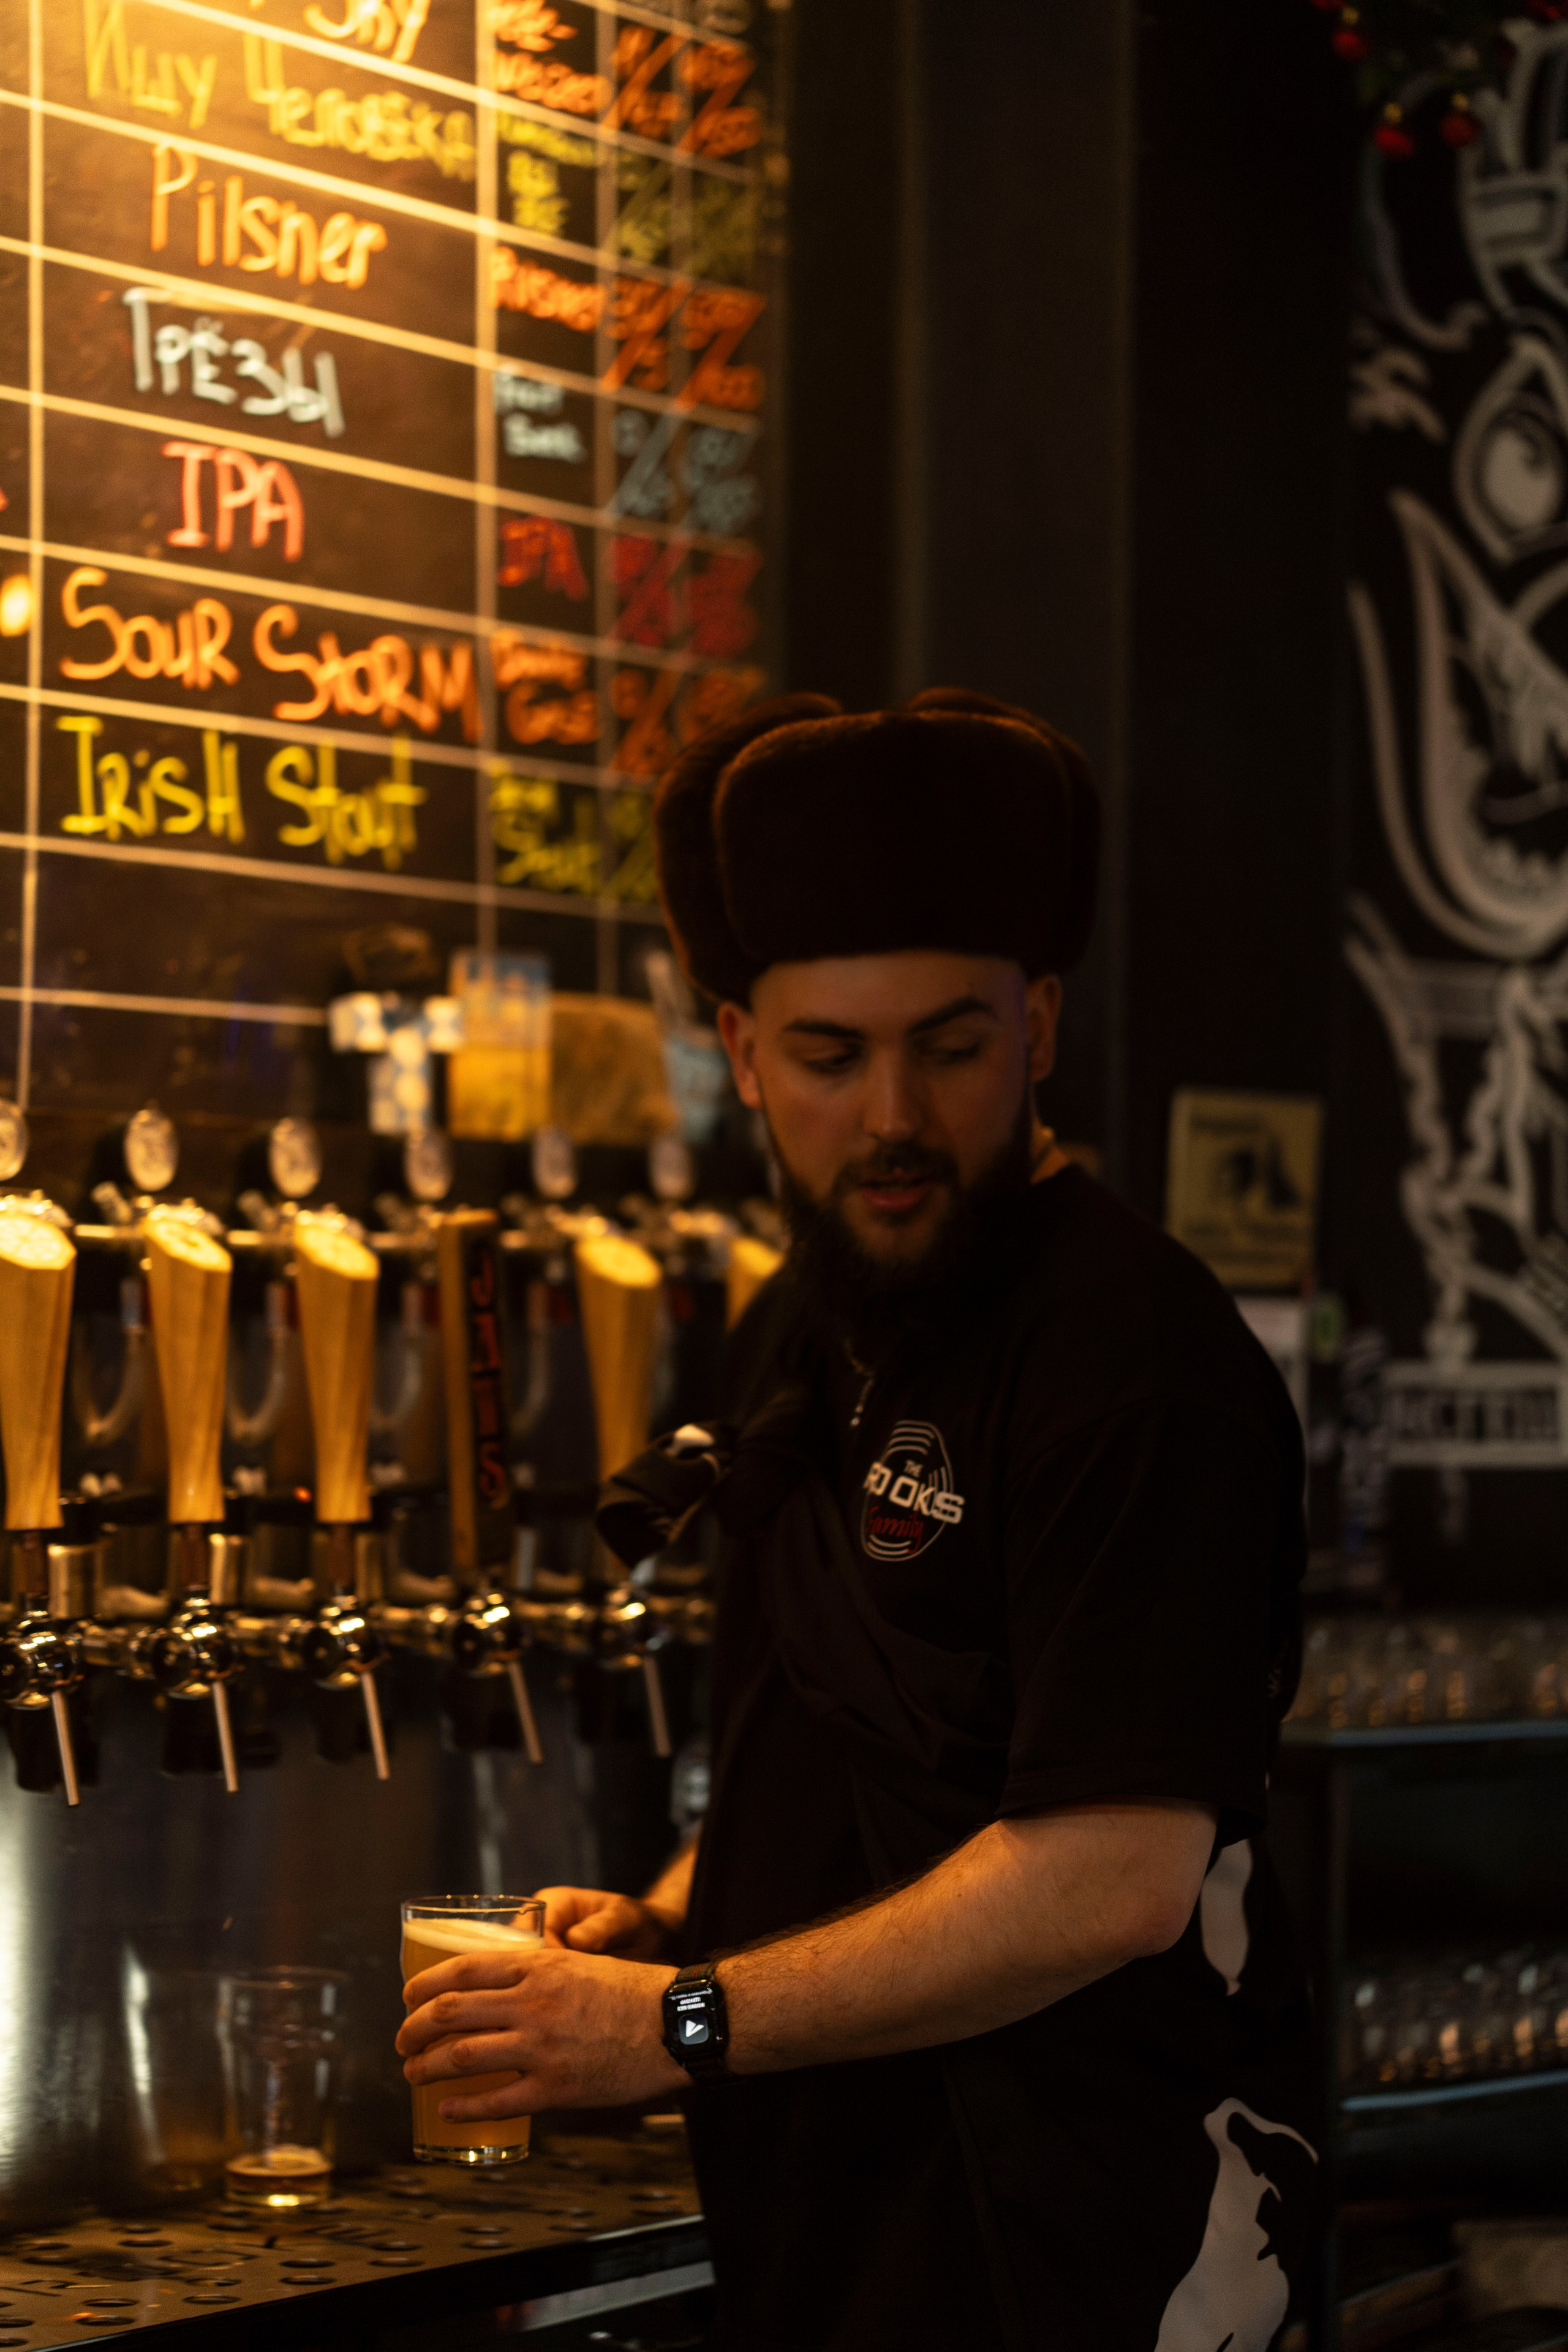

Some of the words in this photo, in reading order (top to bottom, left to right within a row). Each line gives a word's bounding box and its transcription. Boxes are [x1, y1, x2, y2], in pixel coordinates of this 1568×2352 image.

[151, 140, 388, 290] Pilsner
[162, 440, 306, 562] IPA
[265, 731, 428, 872] Stout
